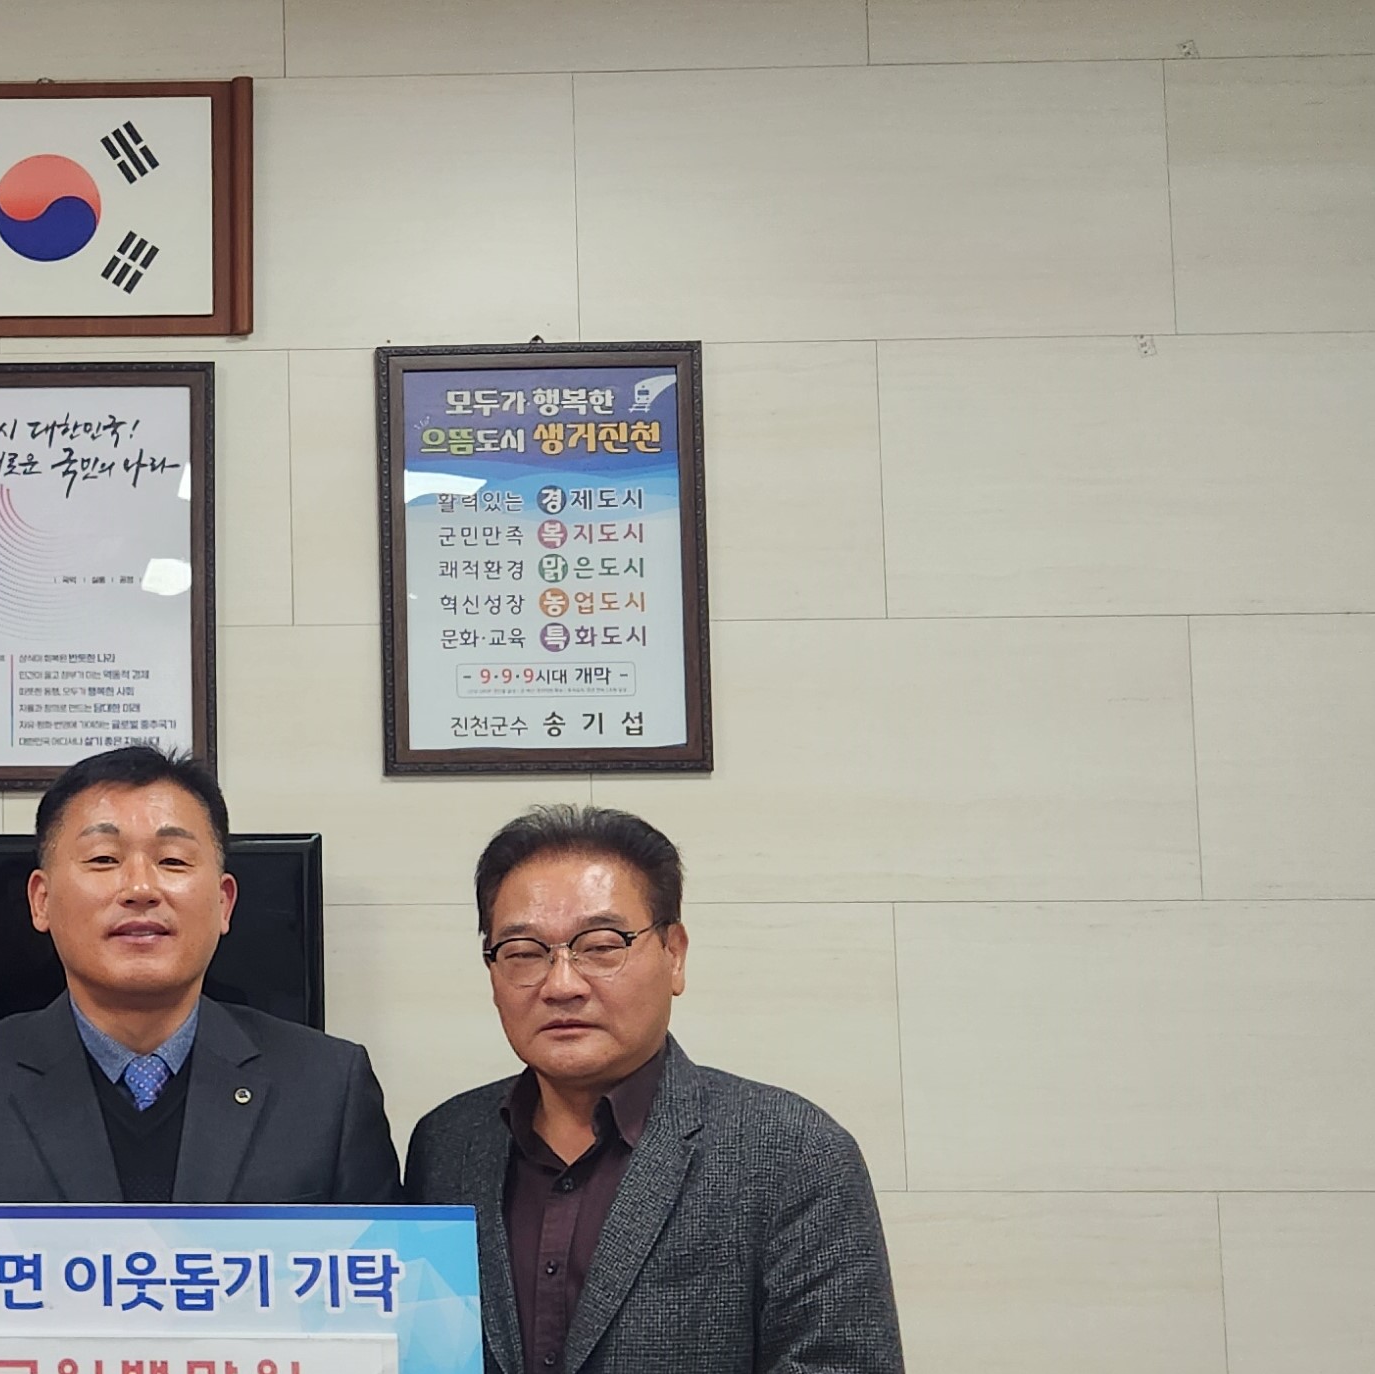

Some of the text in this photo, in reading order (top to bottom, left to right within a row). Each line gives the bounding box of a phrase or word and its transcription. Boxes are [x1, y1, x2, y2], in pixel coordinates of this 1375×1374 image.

[445, 387, 615, 416] 모두가 행복한
[26, 413, 141, 447] 대한민국!
[420, 421, 662, 455] 으뜸도시 생거진천
[51, 447, 115, 498] 국민의
[123, 448, 180, 488] 나라
[437, 490, 523, 513] 활력있는
[438, 525, 524, 547] 군민만족
[438, 558, 524, 581] 쾌적환경
[440, 593, 525, 615] 혁신성장
[575, 667, 612, 685] 개막
[450, 716, 529, 738] 진천군수
[64, 1252, 271, 1312] 이웃돕기
[294, 1253, 400, 1313] 기탁
